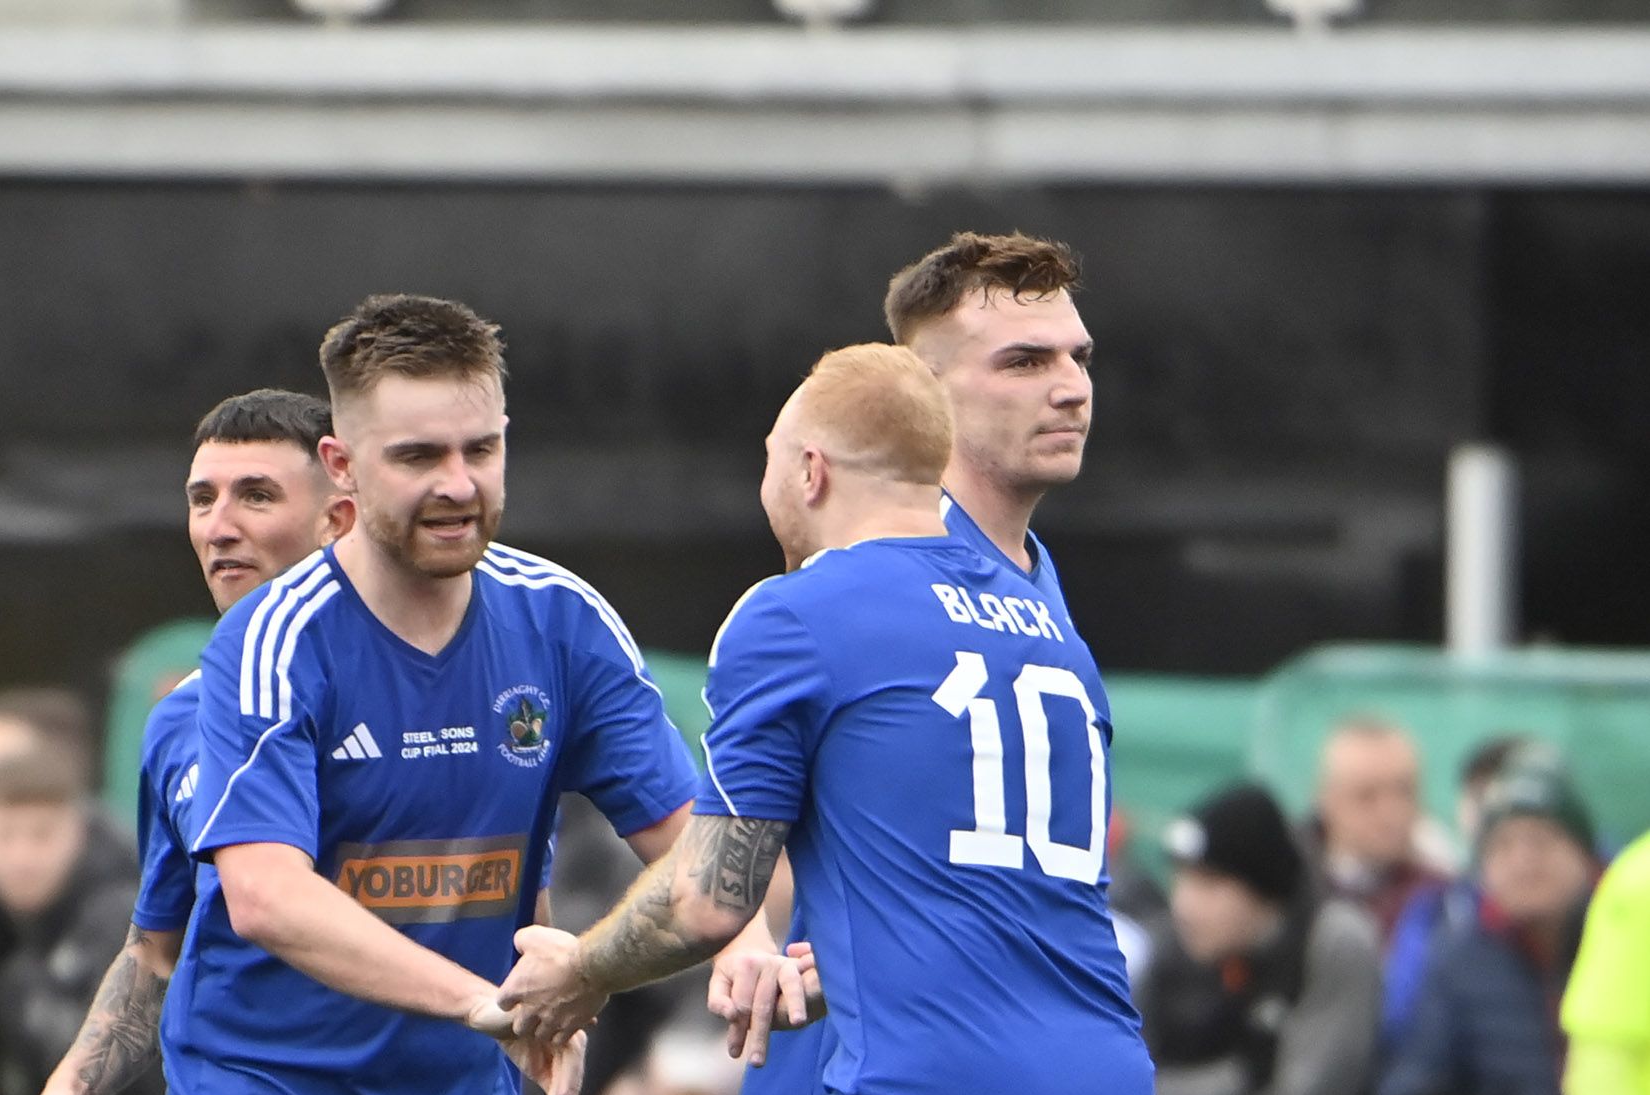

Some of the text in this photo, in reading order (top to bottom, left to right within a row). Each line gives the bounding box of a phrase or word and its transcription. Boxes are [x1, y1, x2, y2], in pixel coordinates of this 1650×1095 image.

[931, 583, 1065, 643] BLACK
[401, 741, 479, 759] CUP FIAL 2024
[403, 726, 475, 744] STEEL SONS
[931, 650, 1106, 886] 10
[347, 858, 516, 899] YOBURGER
